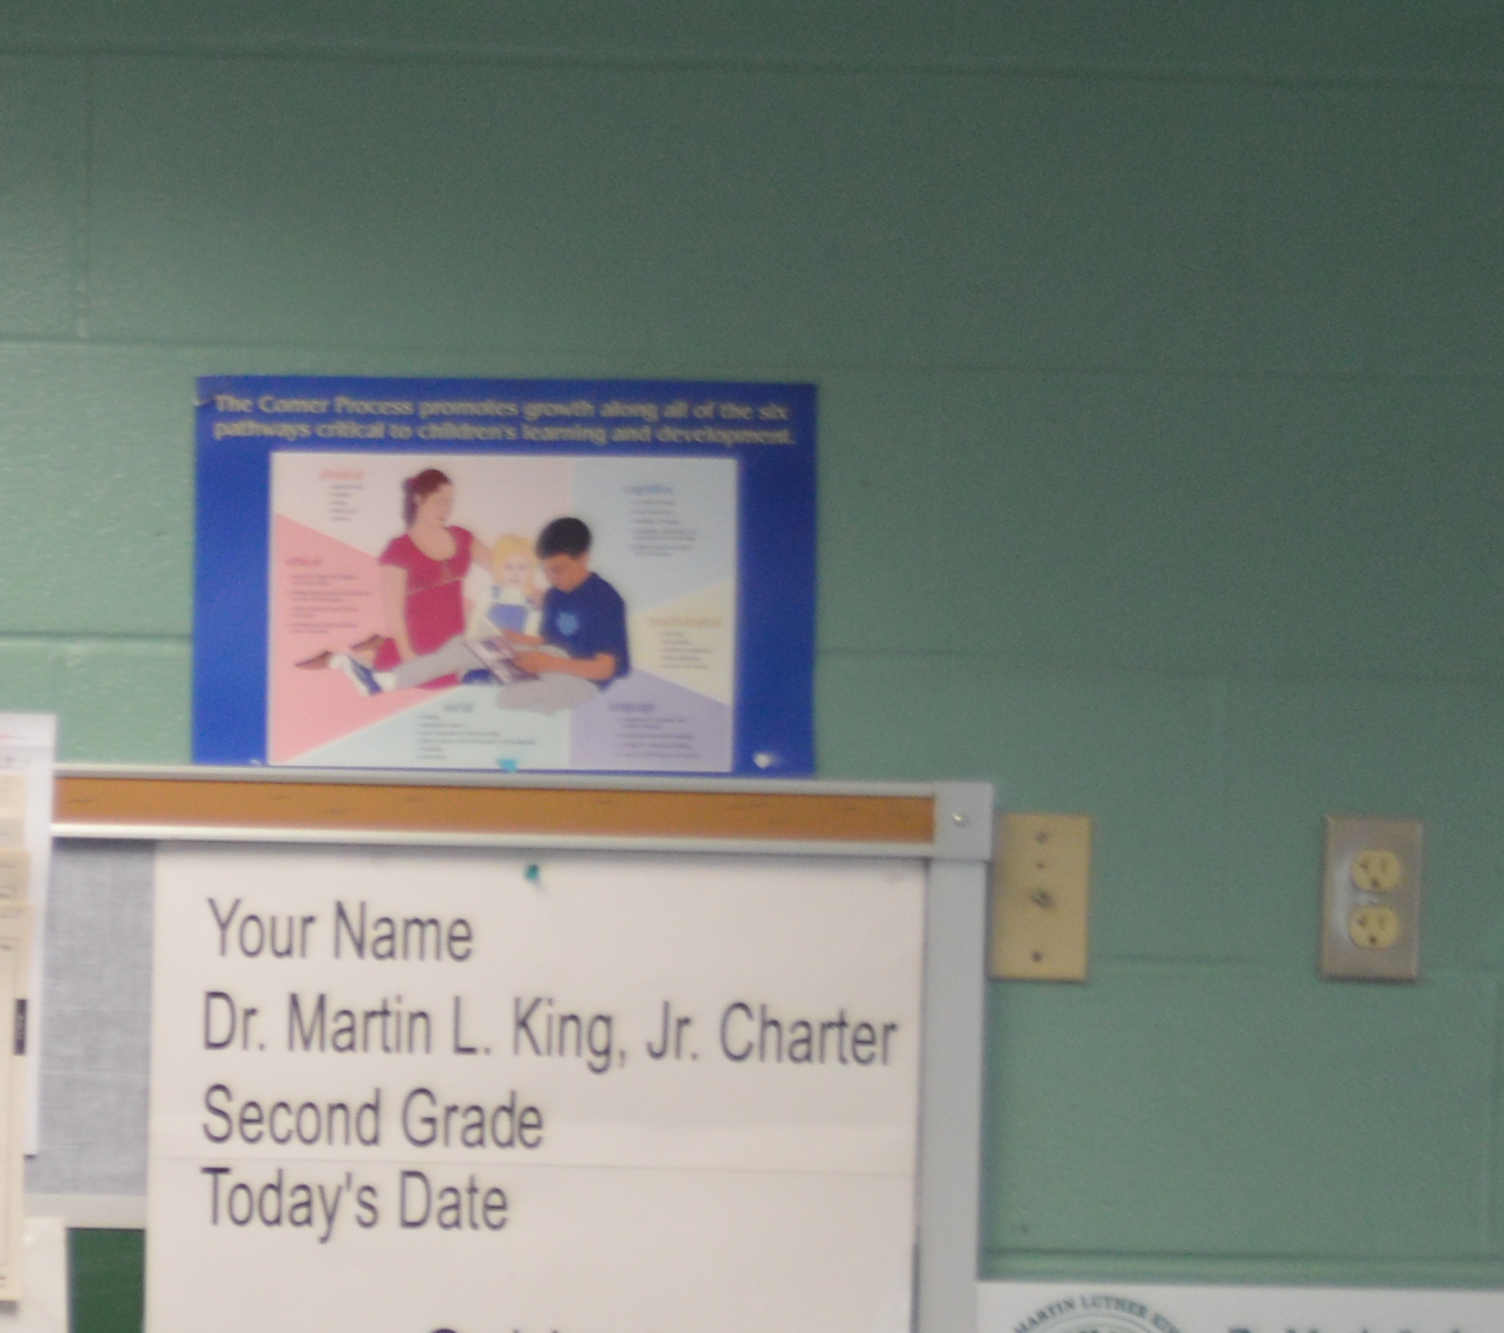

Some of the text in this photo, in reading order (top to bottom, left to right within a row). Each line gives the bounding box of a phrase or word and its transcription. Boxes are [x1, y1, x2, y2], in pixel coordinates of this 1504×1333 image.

[208, 898, 473, 962] Your Name
[204, 991, 898, 1075] Dr. Martin L. King, Jr. Charter
[203, 1083, 543, 1149] Second Grade
[201, 1166, 508, 1244] Today's Date
